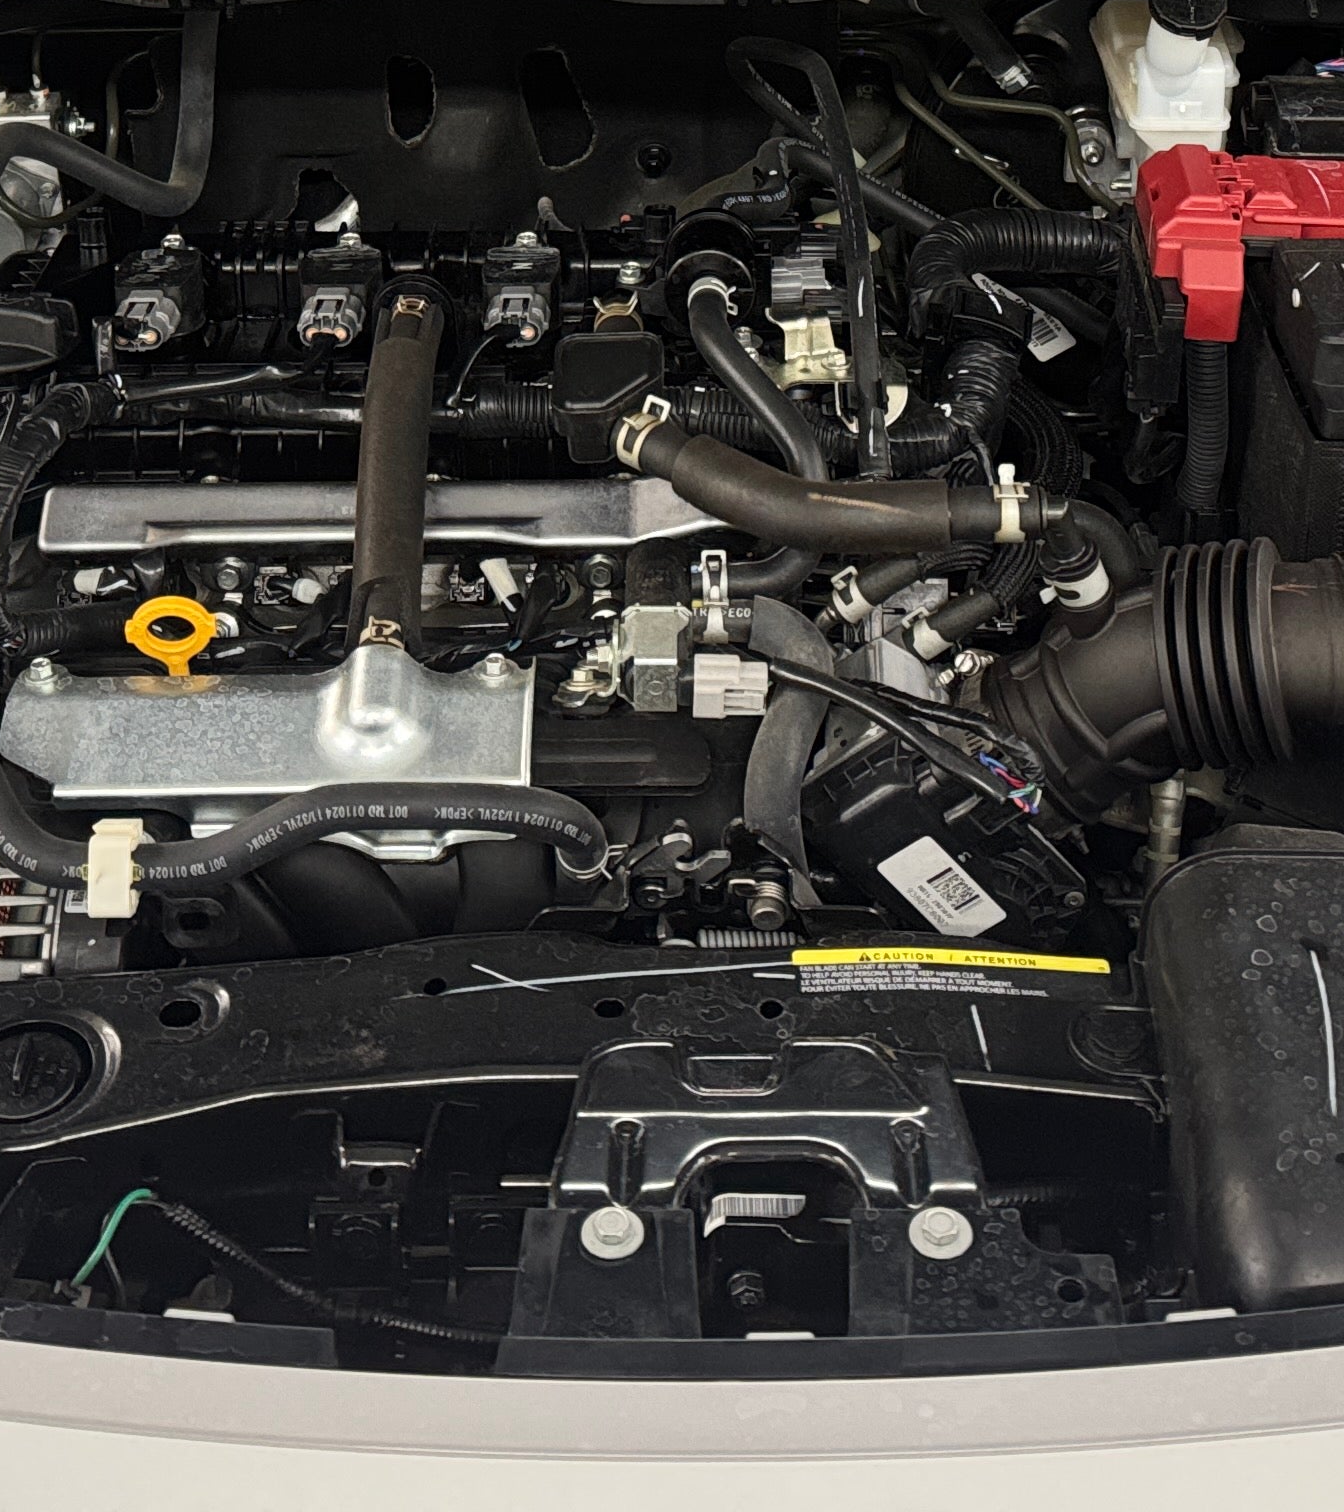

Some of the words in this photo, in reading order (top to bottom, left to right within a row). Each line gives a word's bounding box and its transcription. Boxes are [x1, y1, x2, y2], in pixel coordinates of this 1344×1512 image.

[325, 804, 365, 820] 011024
[389, 805, 409, 819] DOT
[523, 812, 563, 832] 011024
[17, 854, 39, 872] DOT
[207, 855, 228, 875] DOT
[148, 865, 188, 880] 011024
[873, 952, 934, 961] CAUTION
[964, 955, 1037, 967] ATTENTION
[854, 970, 890, 978] PERSONAL
[801, 985, 824, 993] POUR
[852, 983, 877, 991] TOUTE
[959, 986, 1007, 995] APPROCHER
[811, 978, 862, 986] VENTILATEUR
[955, 978, 976, 986] TOUT
